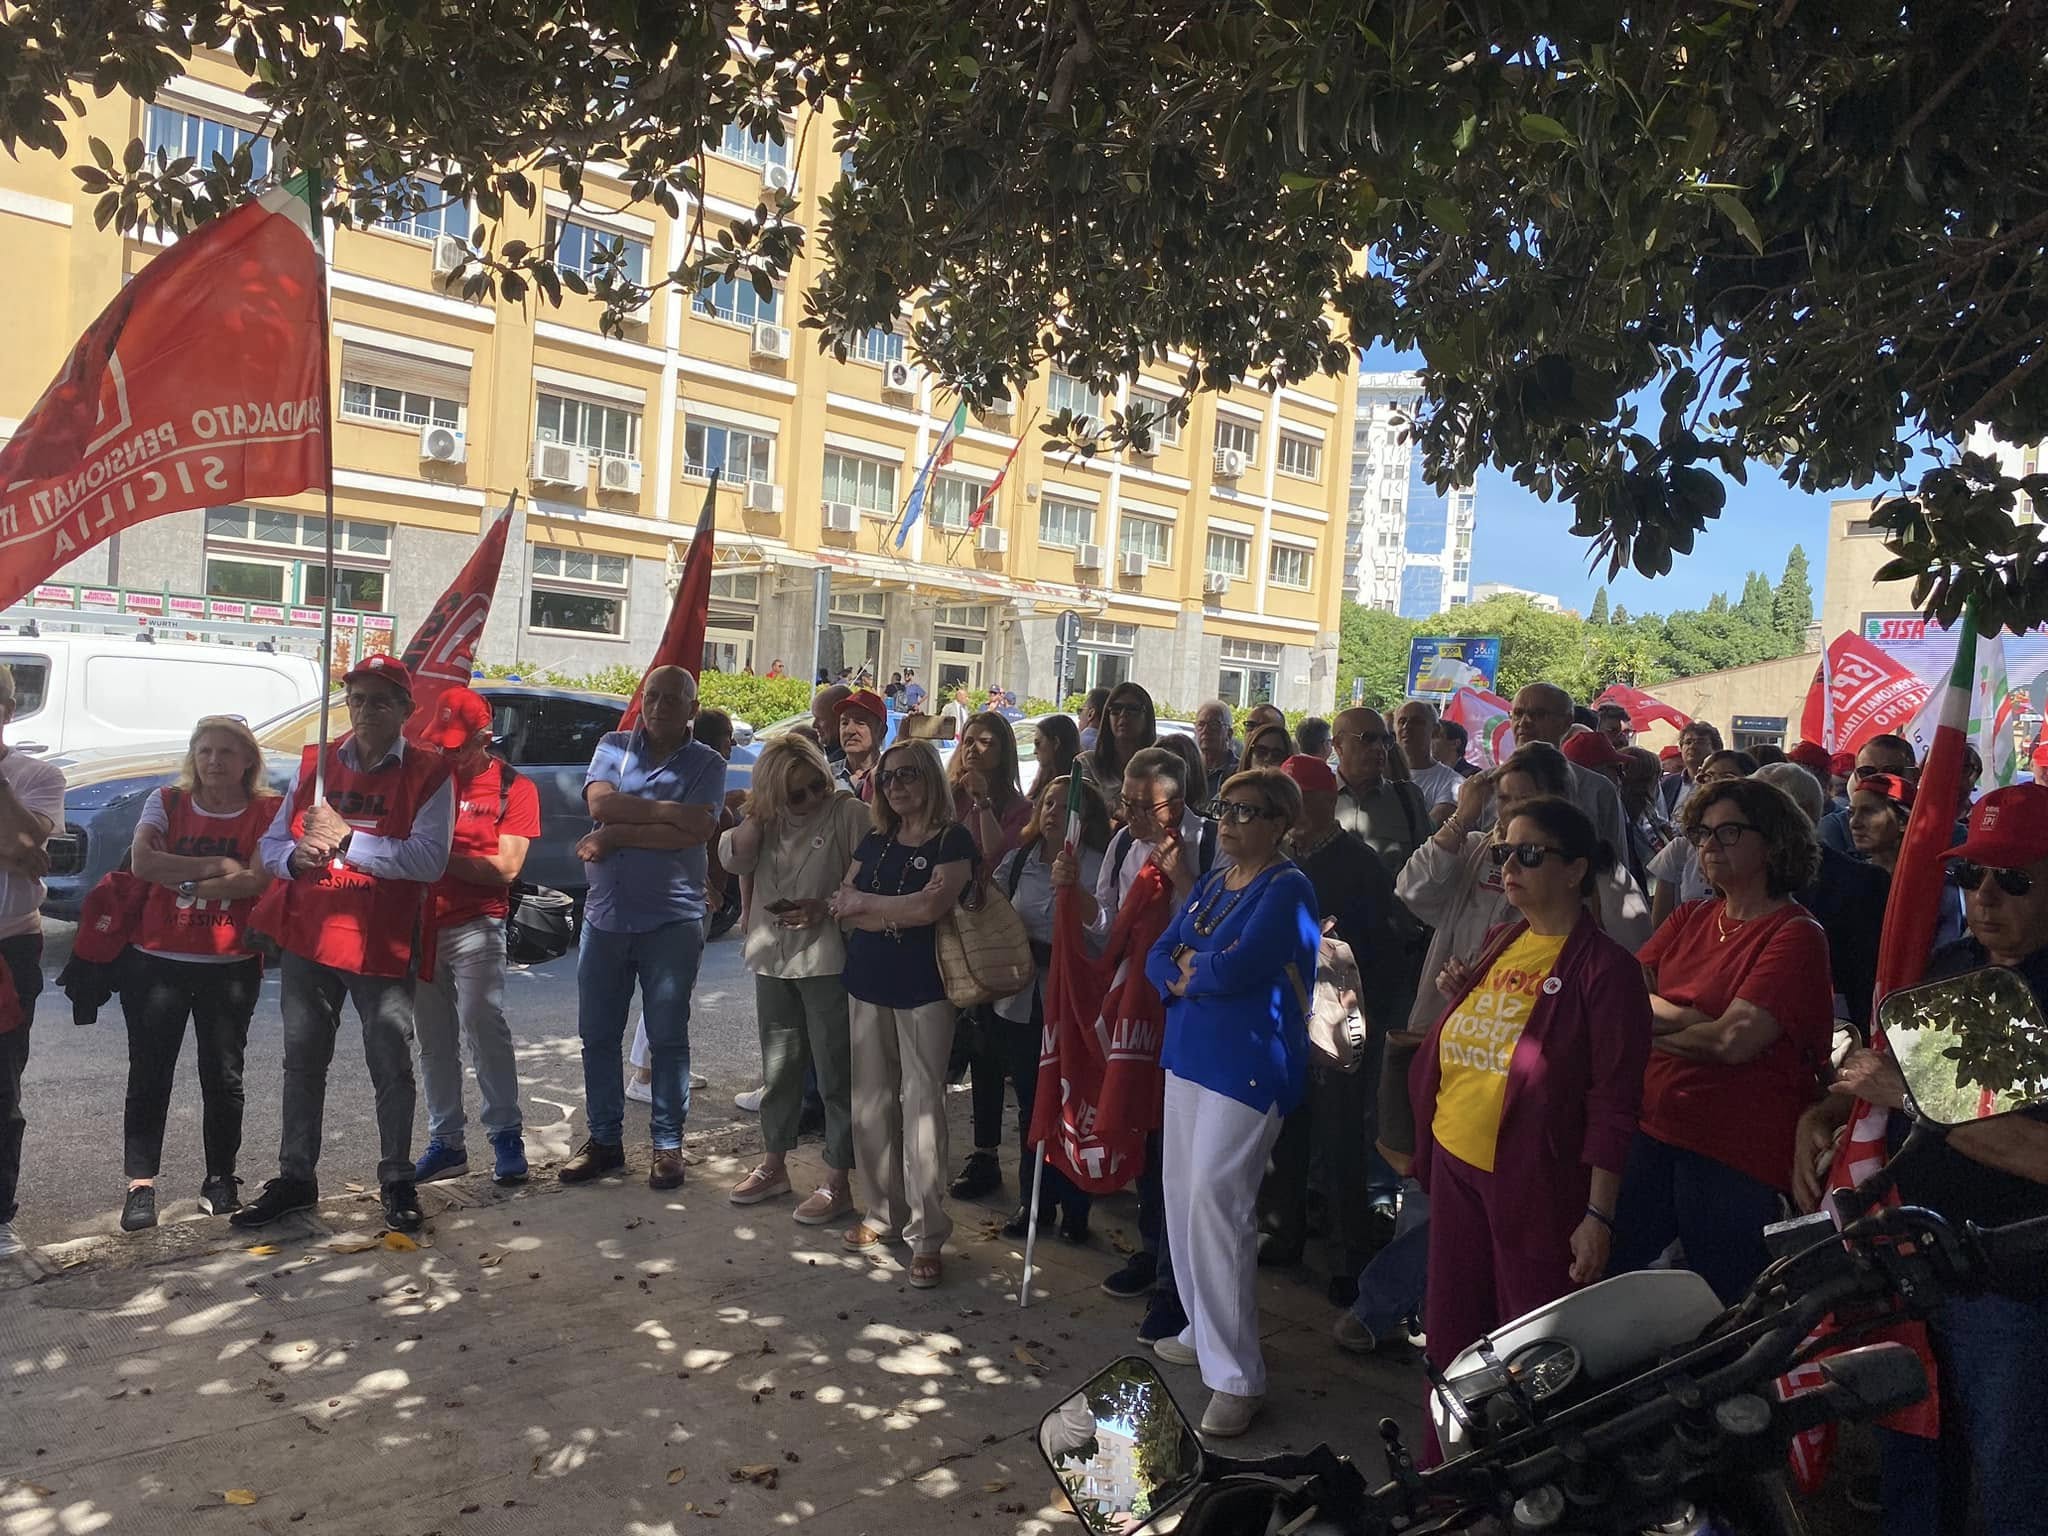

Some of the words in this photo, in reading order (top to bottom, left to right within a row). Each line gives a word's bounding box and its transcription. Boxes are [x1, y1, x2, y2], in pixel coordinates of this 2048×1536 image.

[1880, 620, 1926, 640] SISA
[166, 913, 235, 929] MESSINA
[1442, 1042, 1510, 1076] rivolt
